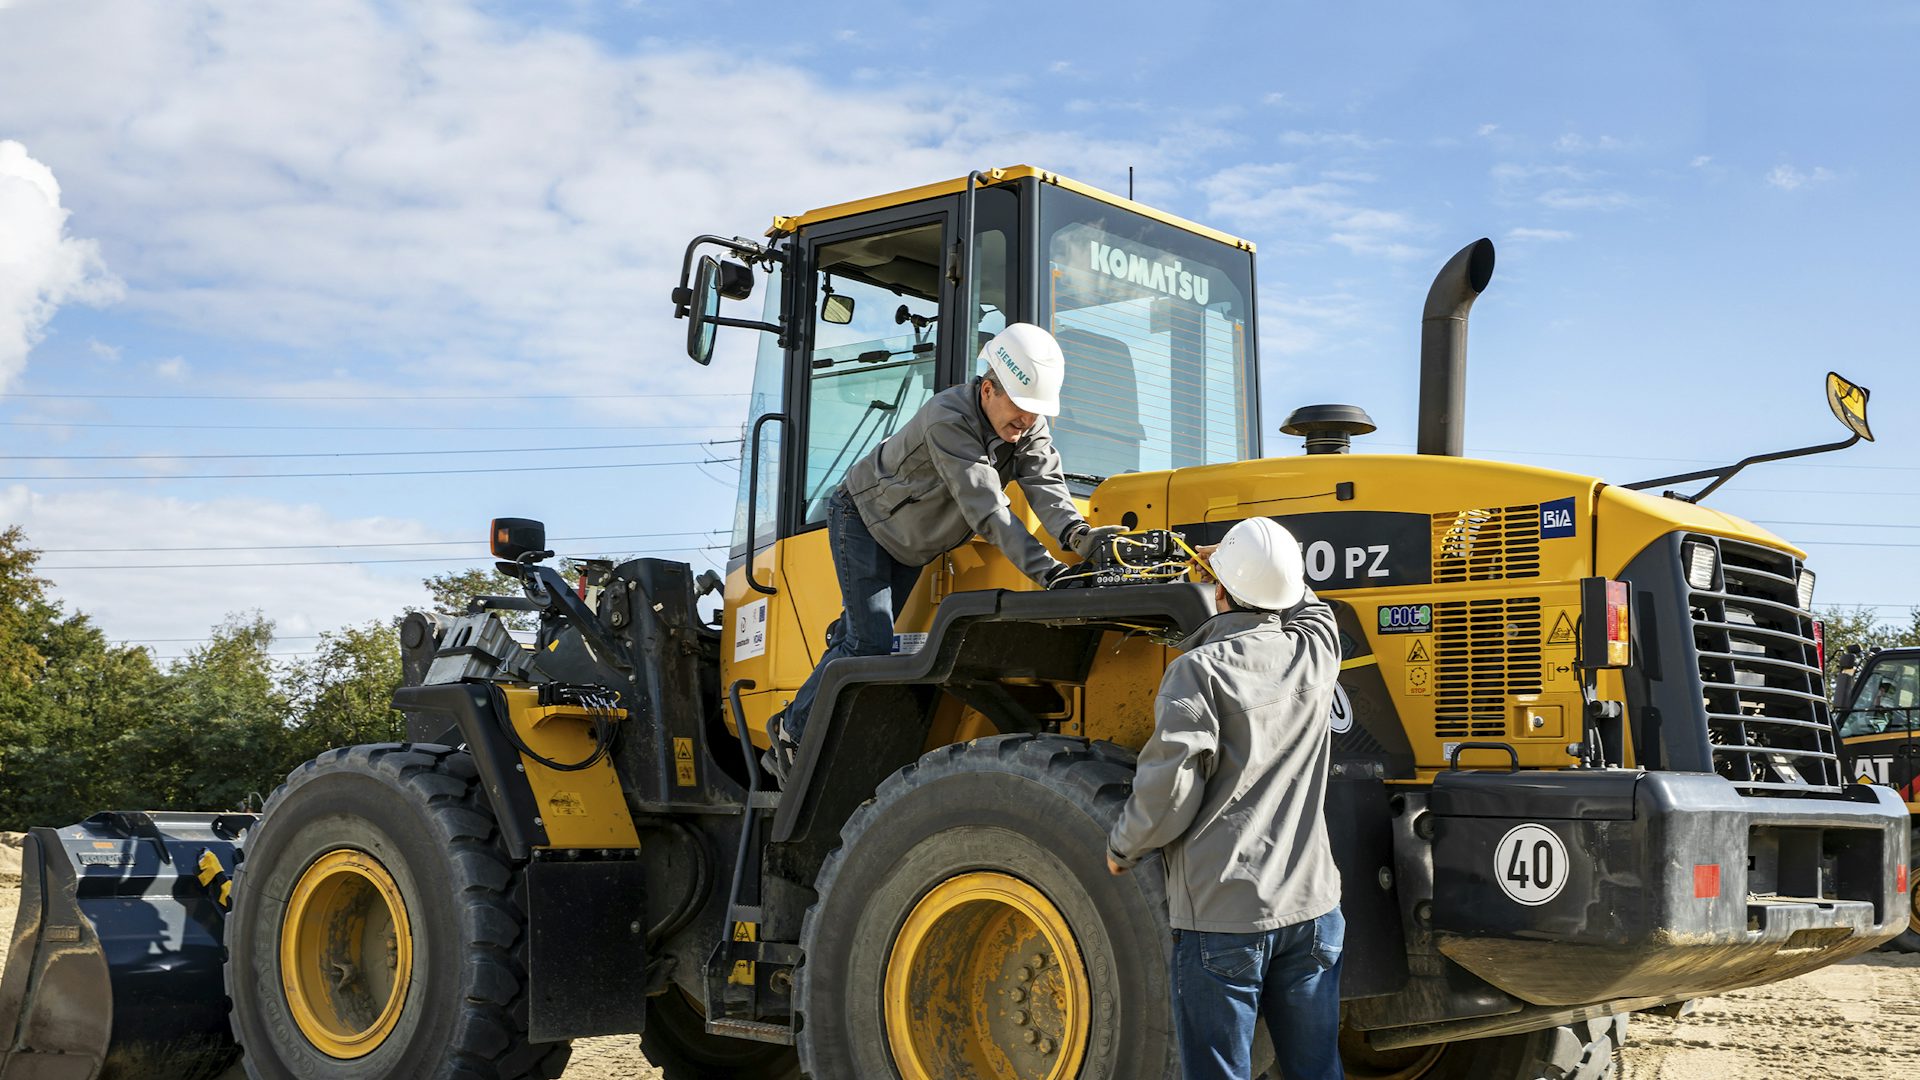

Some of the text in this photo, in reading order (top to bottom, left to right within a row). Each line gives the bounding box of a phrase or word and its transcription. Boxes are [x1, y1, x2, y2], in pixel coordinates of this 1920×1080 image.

[1090, 240, 1209, 305] KOMATSU
[996, 346, 1031, 386] SIEMENS
[1299, 541, 1389, 581] 0 PZ
[1330, 687, 1346, 720] 0
[1507, 840, 1553, 889] 40
